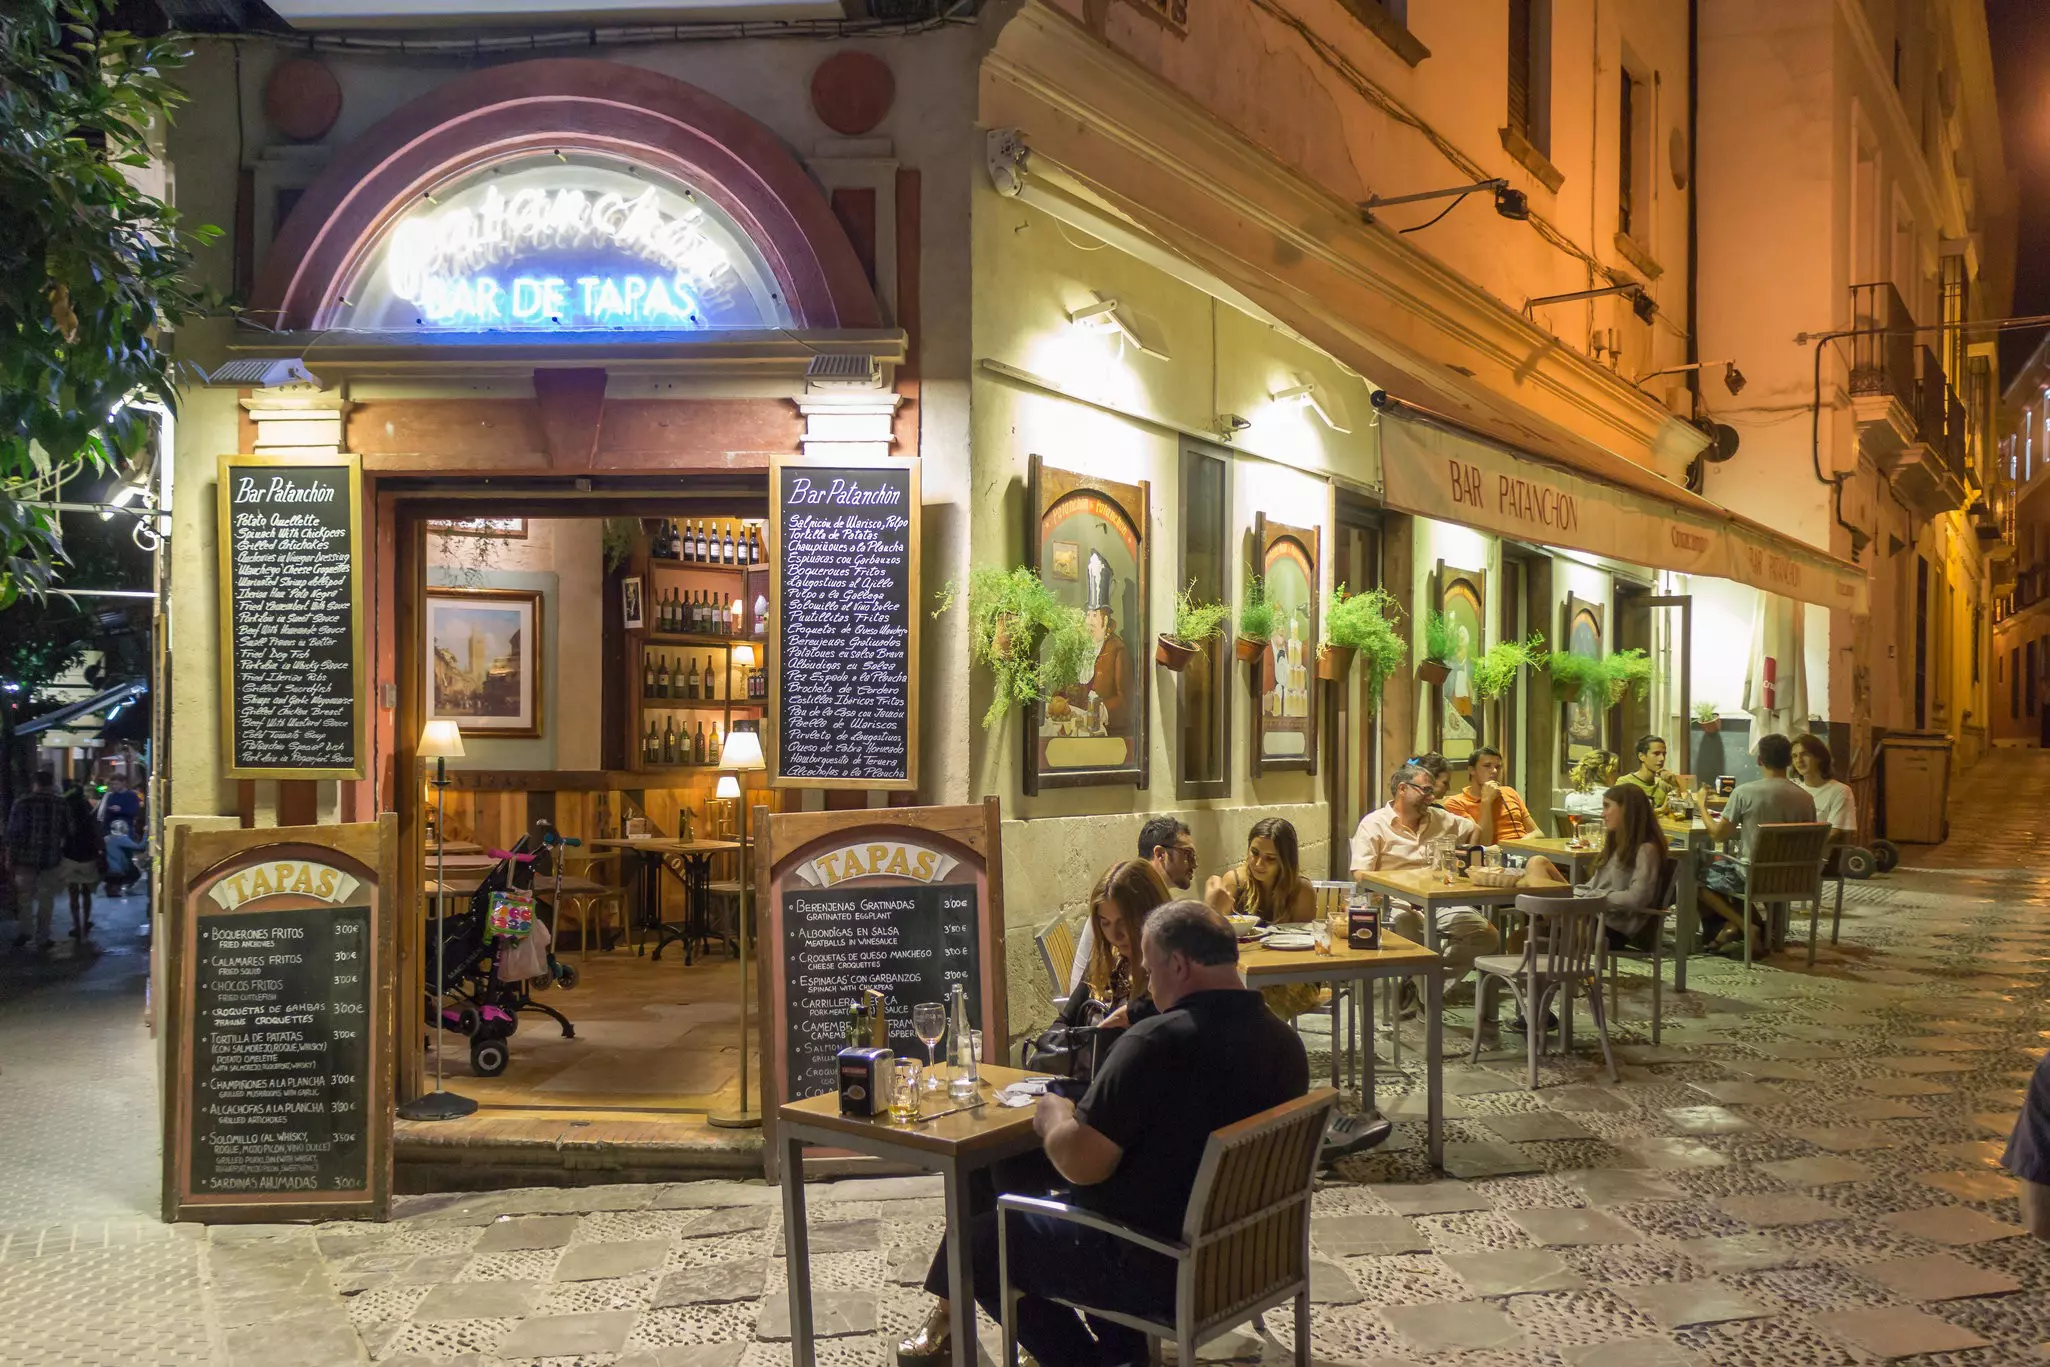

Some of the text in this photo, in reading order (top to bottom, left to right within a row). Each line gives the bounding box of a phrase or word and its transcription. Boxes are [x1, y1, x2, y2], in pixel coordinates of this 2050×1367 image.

[423, 275, 696, 319] BAR DE TAPAS
[235, 477, 265, 503] Bar
[788, 478, 826, 503] Bar
[1449, 460, 1578, 533] BAR PATANCHON
[834, 516, 844, 528] de
[886, 515, 908, 531] Pulpo
[789, 529, 878, 539] Tortilla de Patatas
[867, 541, 904, 552] Plancha
[788, 553, 833, 566] Espinacas
[837, 556, 851, 564] con
[788, 564, 885, 579] Boquerones Fritos
[850, 578, 860, 587] al
[788, 589, 816, 601] Pulpo
[828, 590, 839, 598] la
[840, 591, 884, 603] Gallega
[789, 600, 838, 610] Solomillo
[841, 601, 853, 611] al
[872, 601, 900, 611] Dulce
[854, 613, 889, 622] Fritas
[788, 623, 877, 637] Croquetas de Queso
[877, 648, 904, 658] Brava
[863, 661, 896, 670] Salsa
[788, 670, 807, 681] Pez
[810, 672, 848, 683] Espada
[860, 672, 869, 681] la
[871, 671, 907, 682] Plancha
[788, 682, 899, 694] Brocheta de Cordero
[789, 695, 904, 706] Costillas Fritas
[788, 706, 806, 716] Pan
[809, 707, 820, 717] de
[822, 708, 832, 717] la
[834, 708, 856, 717] Casa
[789, 717, 897, 729] Paella de Mariscos
[837, 730, 848, 740] de
[788, 742, 862, 752] Queso de Cabra
[853, 755, 862, 764] de
[851, 768, 861, 776] la
[864, 767, 904, 777] Plancha
[816, 845, 936, 885] TAPAS
[227, 864, 337, 903] TAPAS
[796, 900, 855, 912] BERENJENAS
[860, 899, 915, 910] GRATINADAS
[212, 927, 303, 940] BOQUERONES FRITOS
[857, 927, 899, 936] EN SALSA
[805, 939, 845, 947] MEATBALLS
[212, 955, 302, 967] CALAMARES FRITOS
[799, 952, 845, 963] CROQUETAS
[861, 952, 887, 960] QUESO
[890, 949, 932, 958] MANCHEGO
[869, 973, 921, 983] GARBANZOS
[211, 980, 283, 991] CHOCOS FRITOS
[808, 985, 837, 993] SPINACH
[212, 1006, 264, 1016] CROQUETAS
[269, 1005, 280, 1013] DE
[286, 1003, 326, 1012] GAMBAS
[255, 1015, 313, 1024] CROQUETTES
[211, 1031, 303, 1044] TORTILLA DE PATATAS
[269, 1079, 275, 1087] A
[276, 1078, 286, 1087] LA
[287, 1076, 325, 1087] PLANCHA
[210, 1102, 324, 1114] ALCACHOFAS A LA PLANCHA
[209, 1133, 257, 1145] SOLOMILLO
[211, 1176, 317, 1189] SARDINAS AHUMADAS
